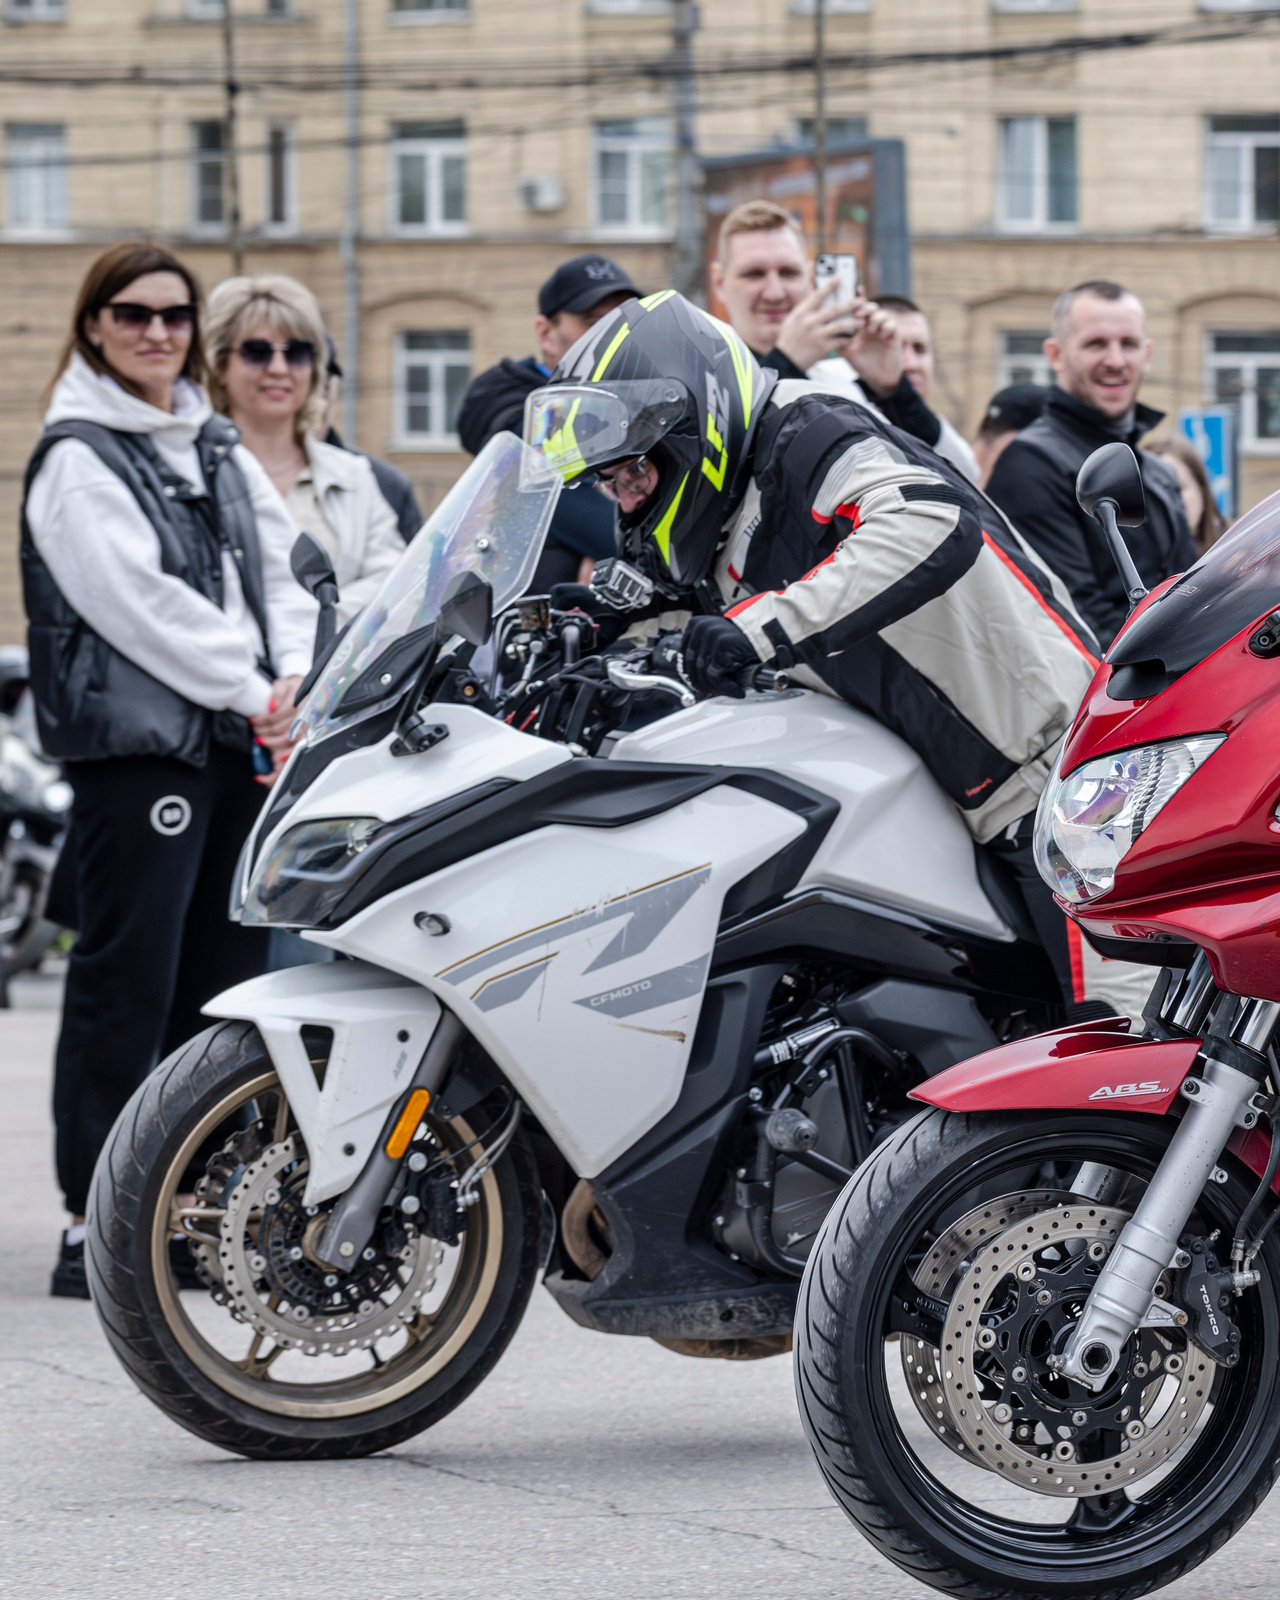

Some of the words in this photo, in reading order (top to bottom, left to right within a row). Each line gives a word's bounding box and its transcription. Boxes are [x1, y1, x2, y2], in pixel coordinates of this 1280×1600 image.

[590, 980, 652, 1007] CFMOTO
[1087, 1080, 1162, 1101] ABS
[1199, 1284, 1220, 1336] TOKICO
